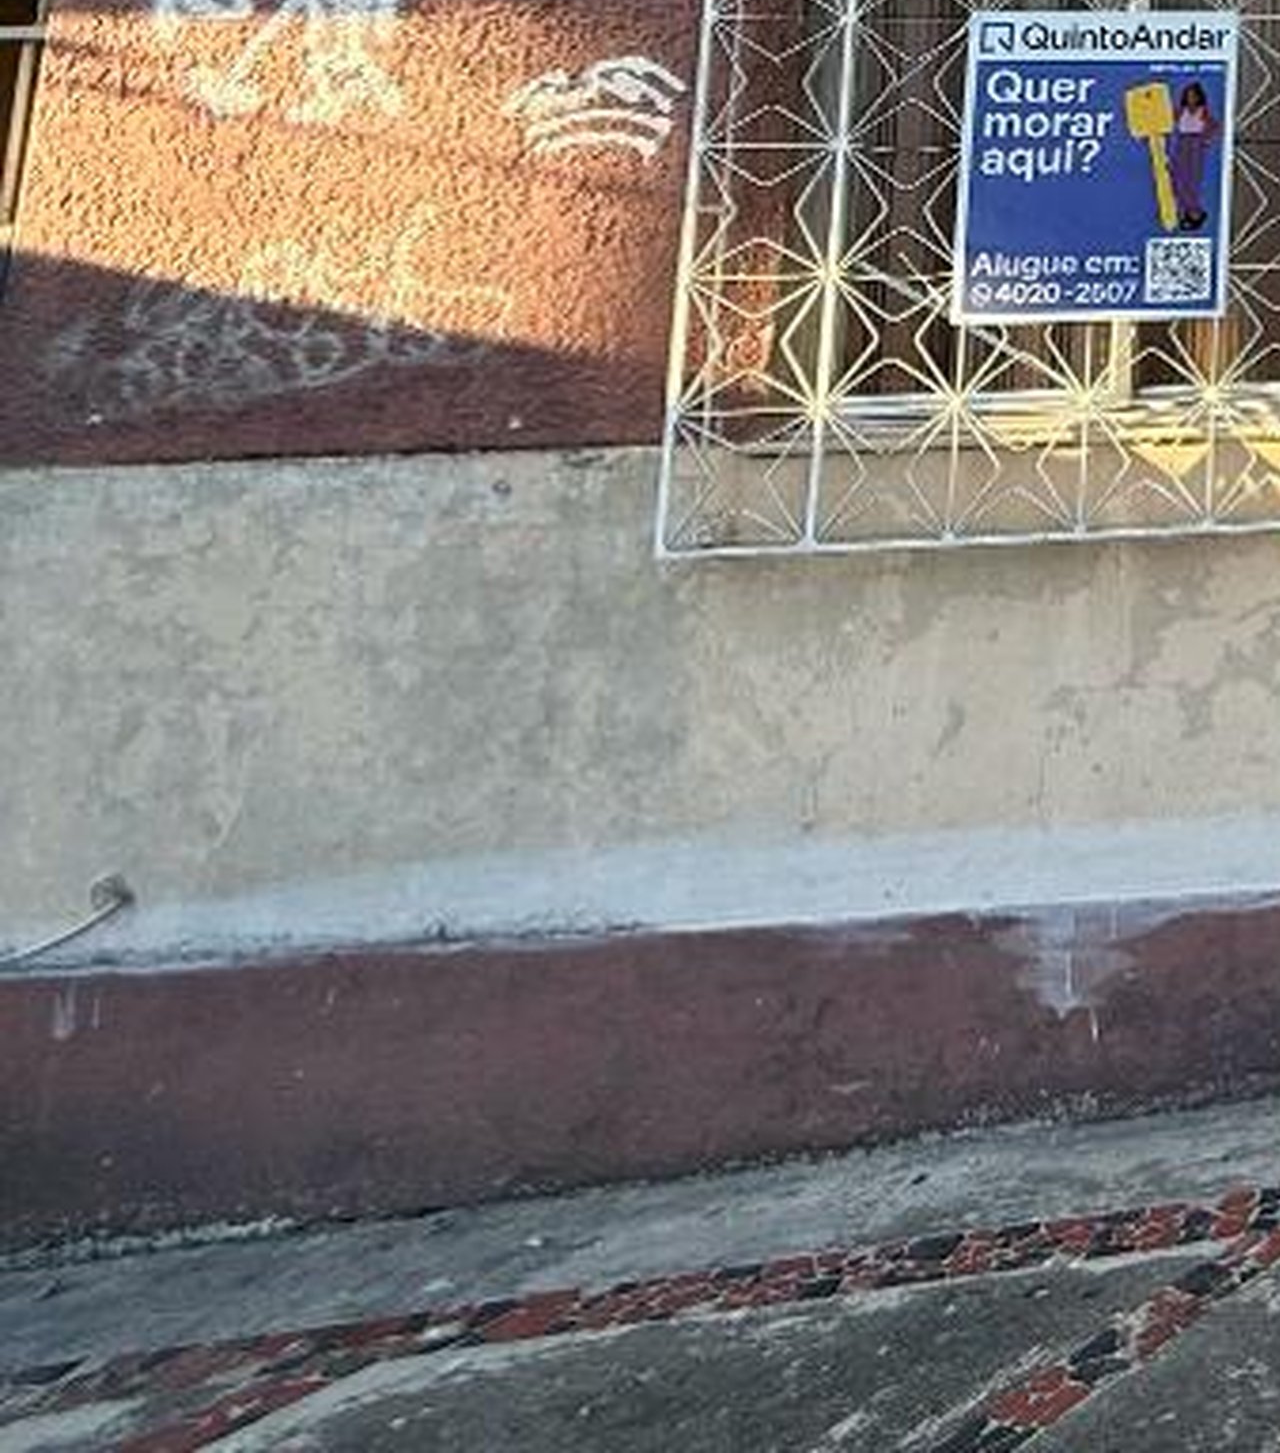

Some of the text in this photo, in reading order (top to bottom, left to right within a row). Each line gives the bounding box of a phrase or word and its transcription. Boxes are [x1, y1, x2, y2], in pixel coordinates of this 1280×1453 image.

[1020, 22, 1231, 52] QuintoAndar
[986, 70, 1096, 104] Quer
[983, 111, 1114, 138] morar
[979, 140, 1101, 182] aqui?
[971, 252, 1078, 281] Alugue
